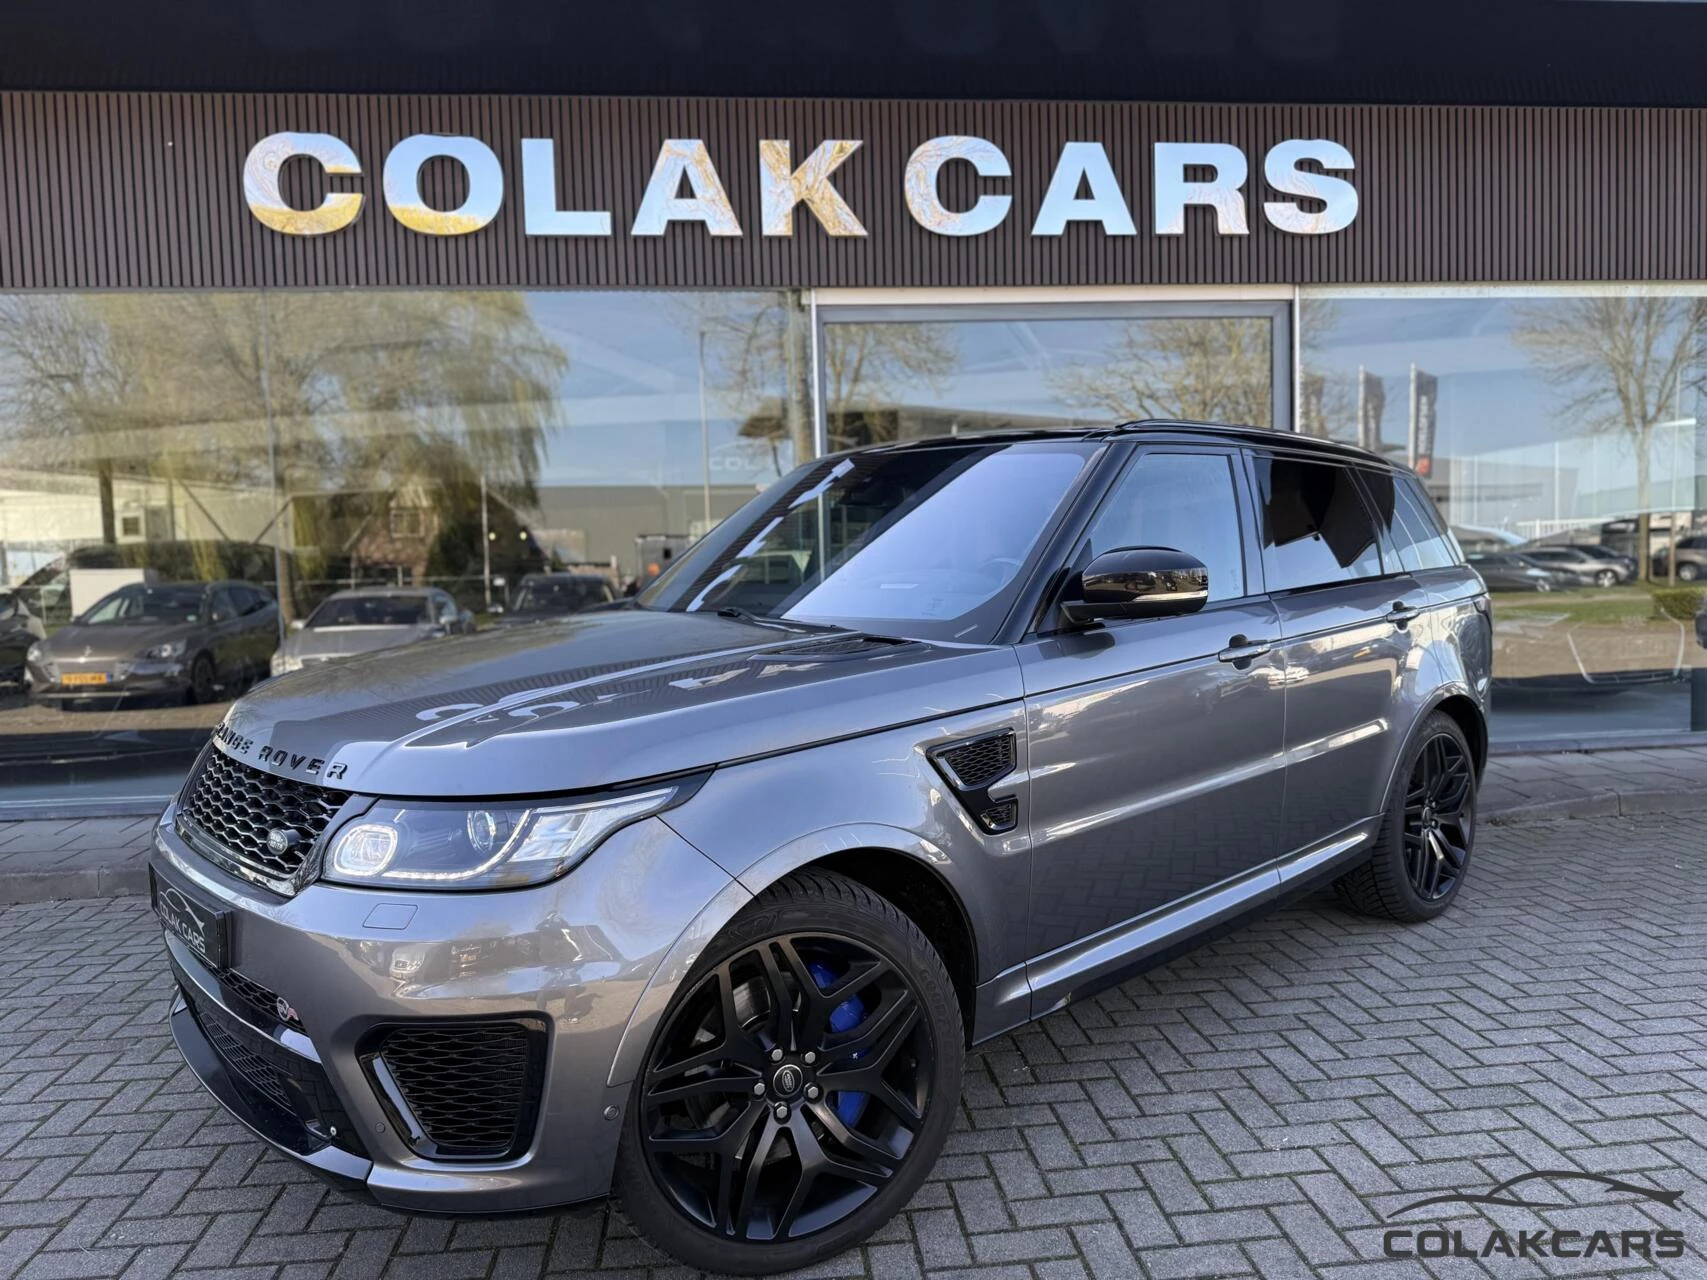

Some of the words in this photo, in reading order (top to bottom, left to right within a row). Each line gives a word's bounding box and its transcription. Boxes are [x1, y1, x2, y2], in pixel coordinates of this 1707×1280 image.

[243, 131, 868, 237] COLAK
[903, 135, 1361, 237] CARS
[215, 722, 254, 756] RANGE
[258, 744, 349, 780] ROVER
[182, 923, 206, 954] CARS
